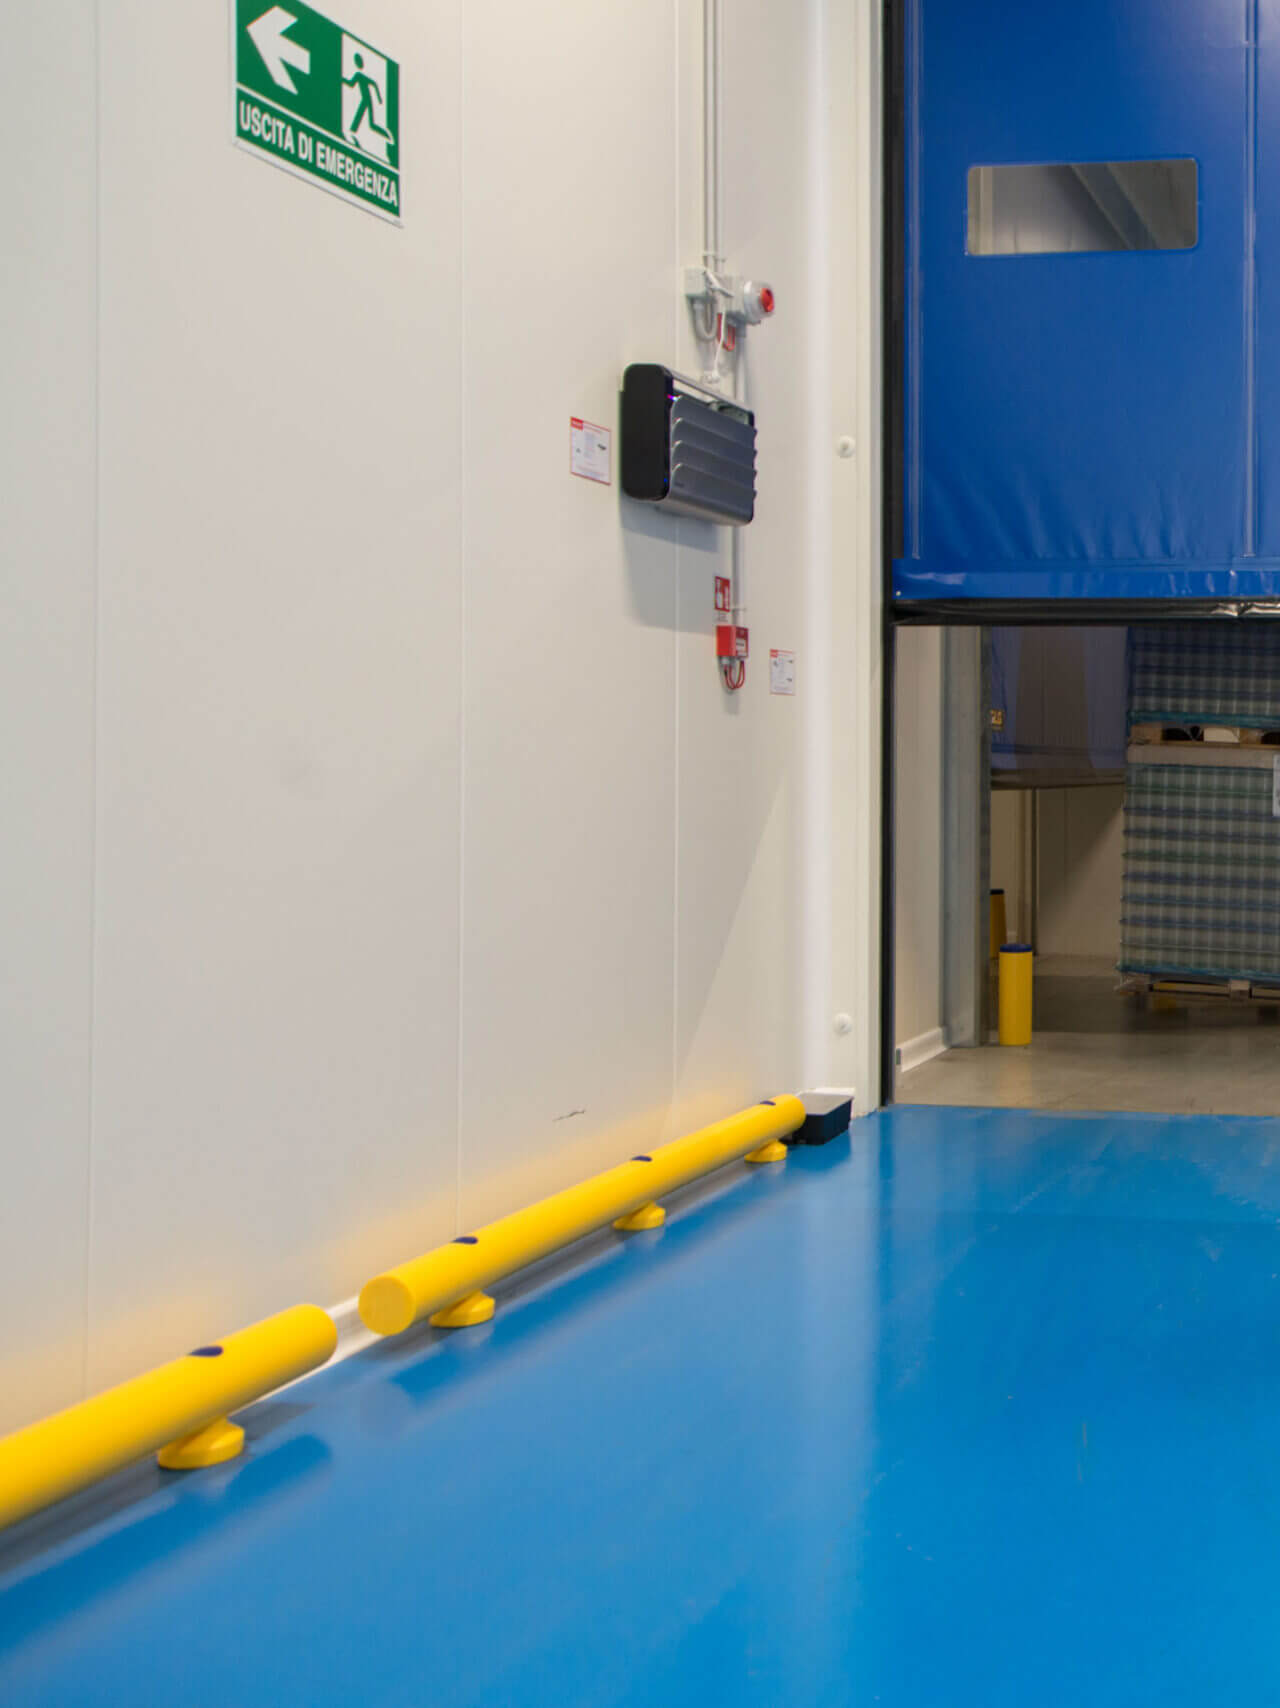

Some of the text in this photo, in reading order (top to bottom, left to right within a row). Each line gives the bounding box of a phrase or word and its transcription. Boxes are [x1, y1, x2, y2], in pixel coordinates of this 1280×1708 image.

[239, 100, 398, 207] USCITA DI EMERGENZA
